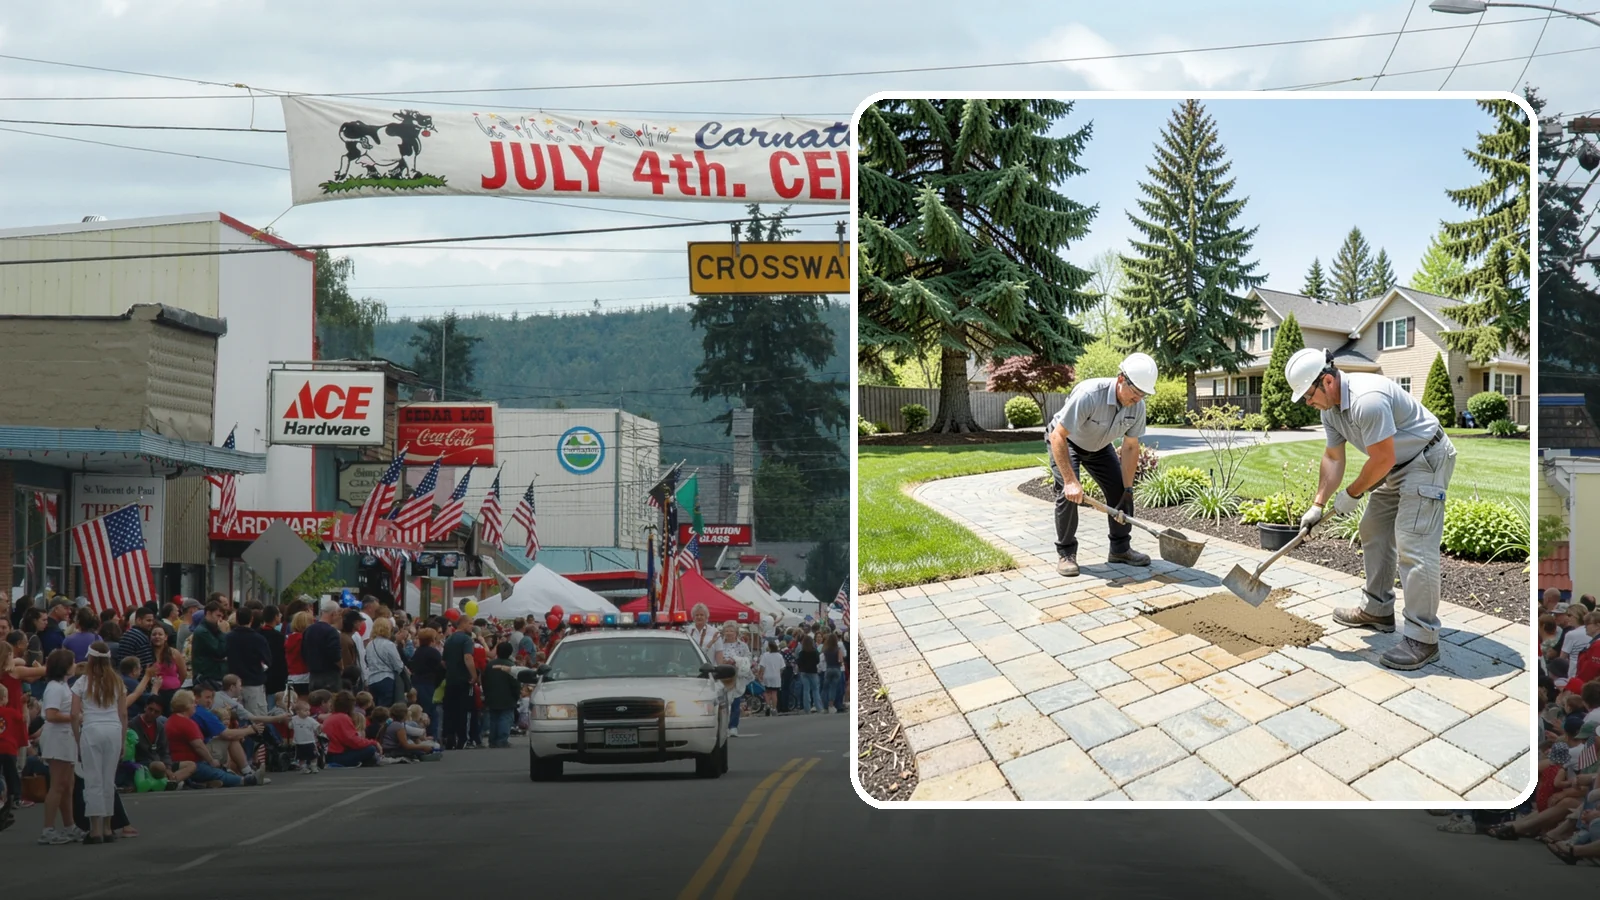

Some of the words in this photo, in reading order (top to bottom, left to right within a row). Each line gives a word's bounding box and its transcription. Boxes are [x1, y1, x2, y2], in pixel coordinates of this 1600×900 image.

[481, 141, 605, 192] JULY
[632, 150, 746, 198] 4th.
[697, 254, 850, 281] CROSSWA
[283, 380, 373, 420] ACE
[406, 409, 452, 422] CEDAR
[283, 421, 371, 437] Hardware
[416, 428, 477, 447] Coca-Cola
[83, 485, 93, 495] St.
[95, 485, 124, 495] Vincent
[126, 486, 135, 495] de
[137, 486, 155, 496] Paul
[699, 535, 730, 544] GLASS
